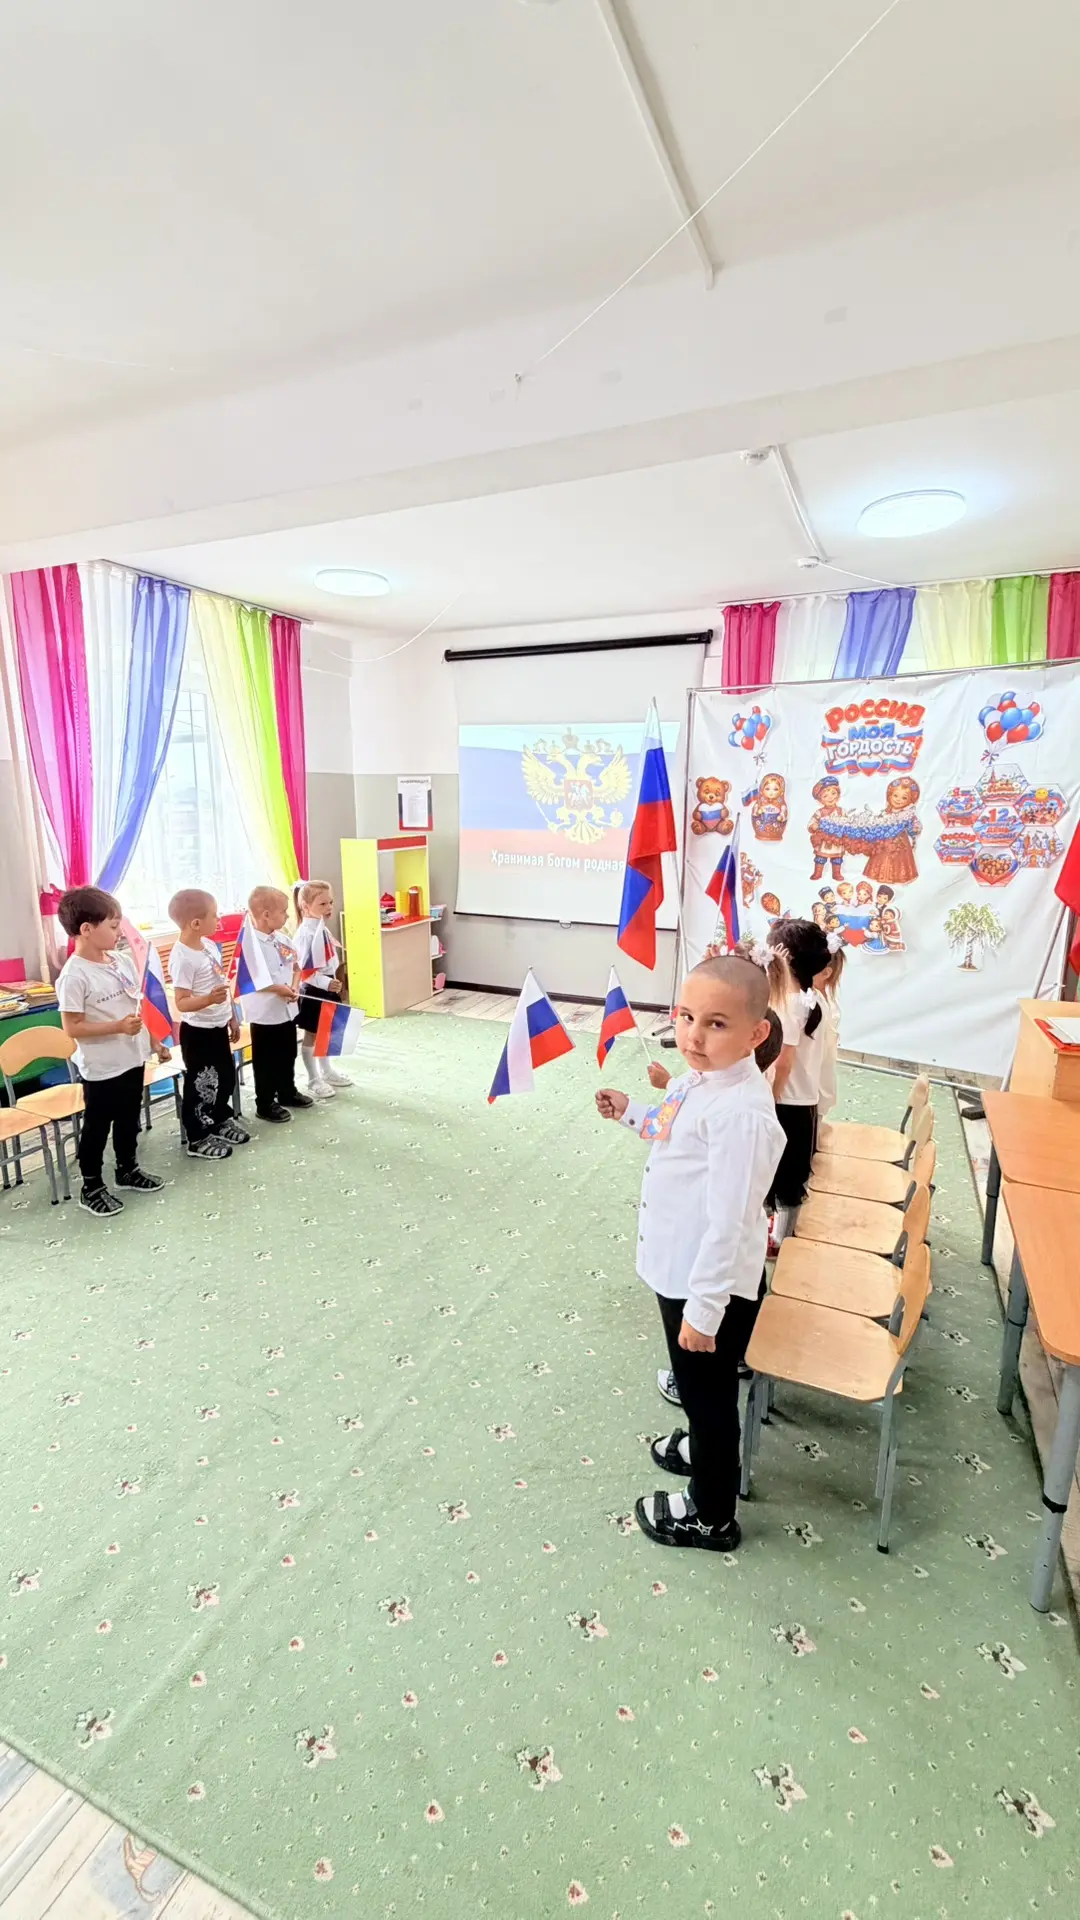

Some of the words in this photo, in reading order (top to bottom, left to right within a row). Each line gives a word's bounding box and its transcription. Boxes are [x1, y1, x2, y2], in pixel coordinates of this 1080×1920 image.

[825, 699, 925, 733] РОССИЯ
[848, 723, 895, 740] МОЯ
[827, 738, 923, 760] ГОРДОСТЬ!
[988, 808, 1010, 823] 12
[491, 849, 543, 867] Хранимая
[547, 853, 580, 868] Богом
[584, 858, 626, 872] родная
